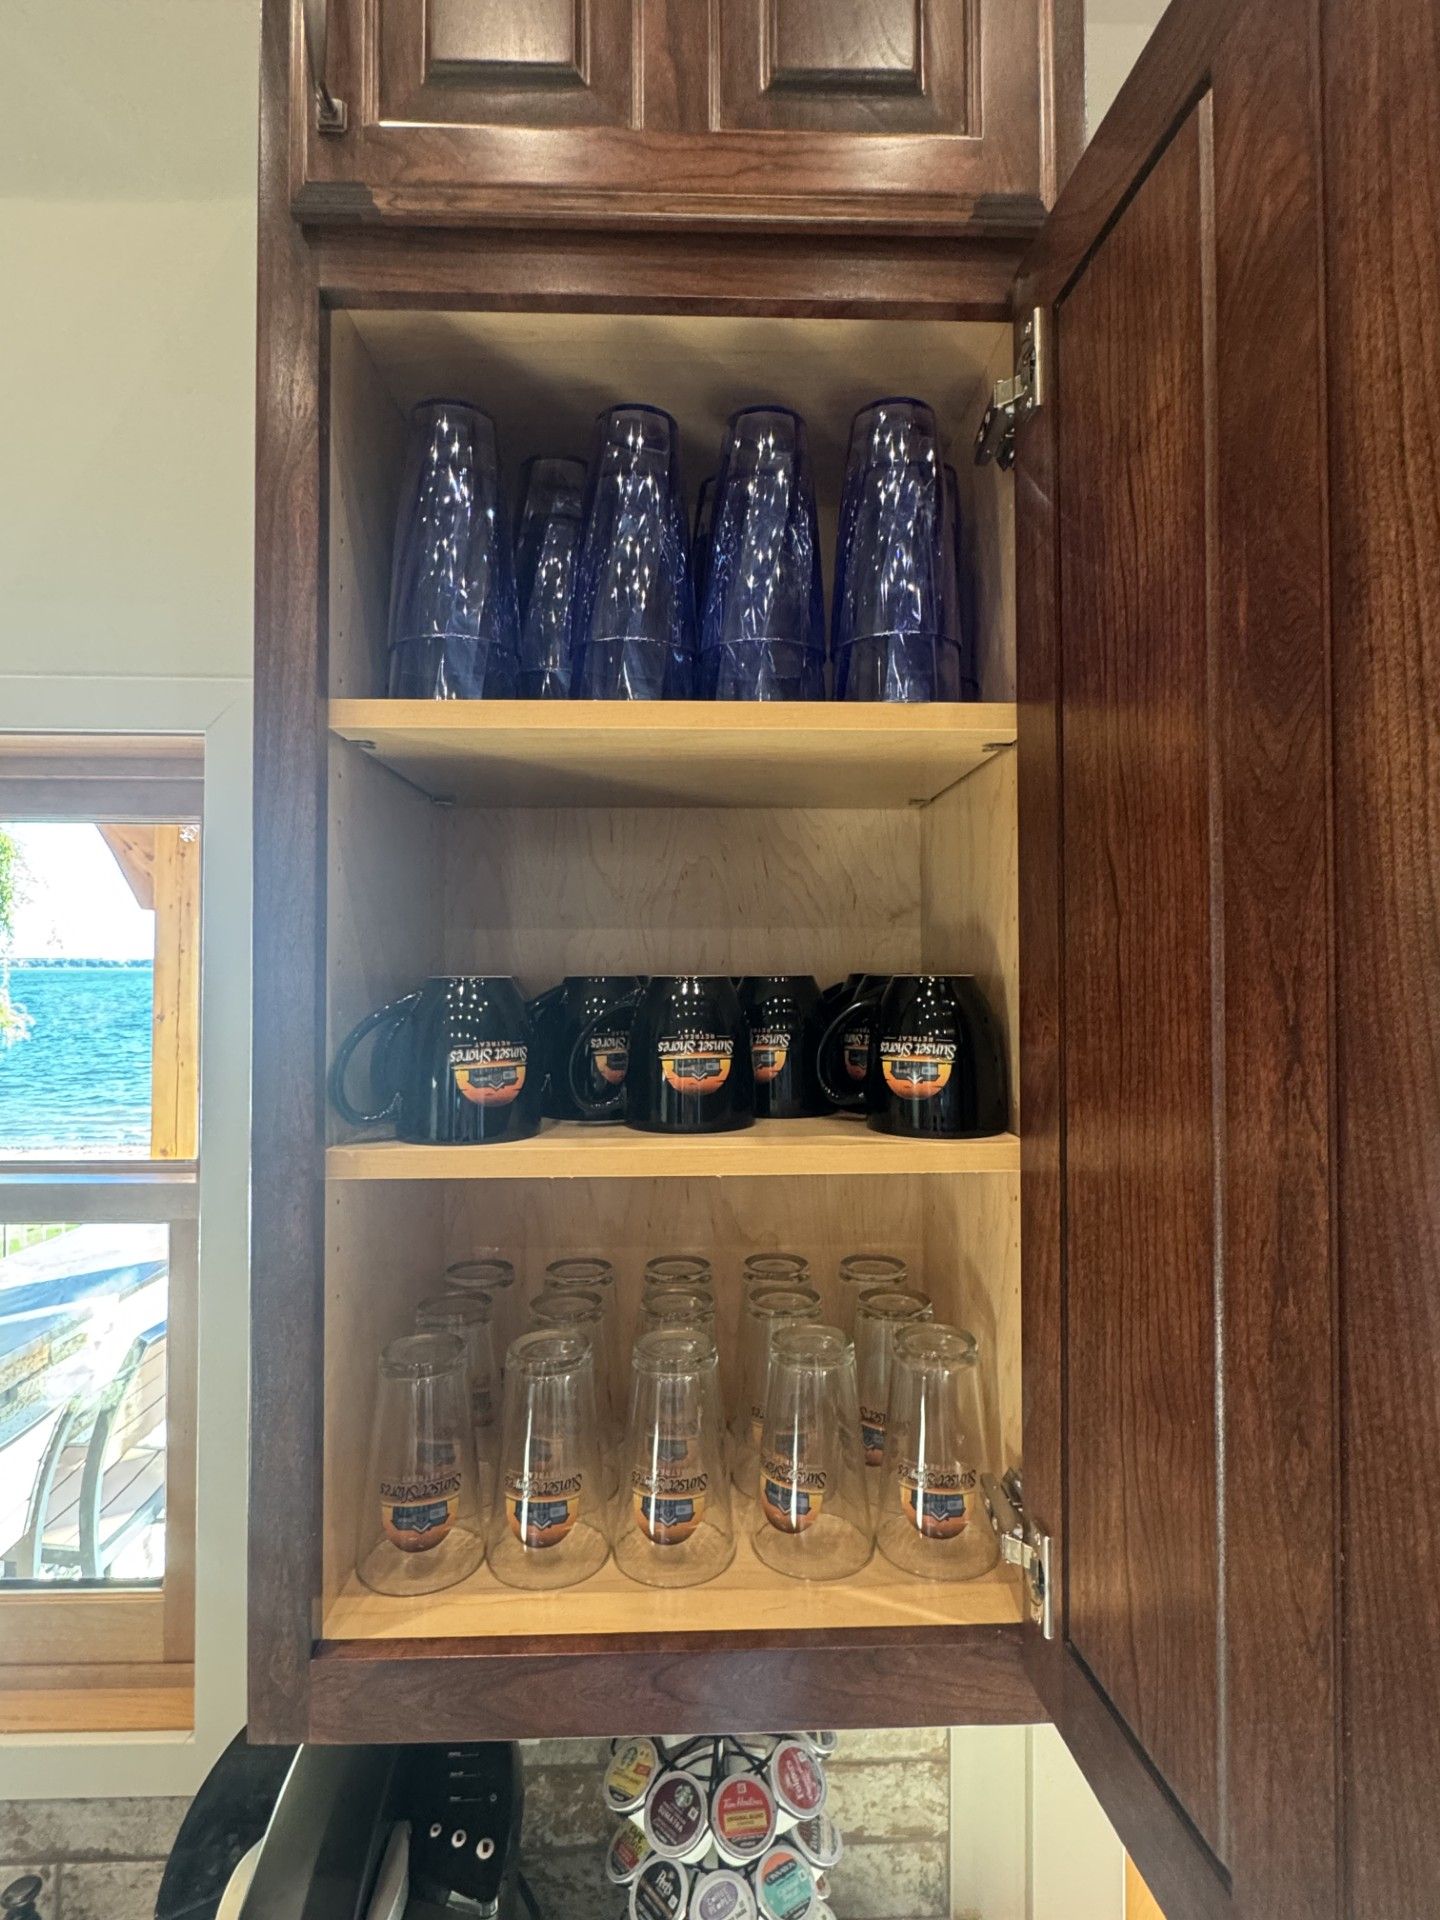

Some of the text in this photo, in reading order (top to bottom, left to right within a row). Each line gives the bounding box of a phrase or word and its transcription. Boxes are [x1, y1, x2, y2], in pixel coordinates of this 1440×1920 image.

[474, 1040, 511, 1048] RETREAT
[590, 1037, 626, 1050] Shores
[658, 1039, 734, 1056] Sunset Shores
[880, 1041, 957, 1061] Sunset Shores
[450, 1046, 527, 1064] Sunset Shores
[422, 1472, 461, 1497] Sunset
[543, 1473, 582, 1495] Sunset
[669, 1473, 709, 1492] Sunset
[938, 1468, 977, 1488] Sunset
[380, 1482, 418, 1504] Shores
